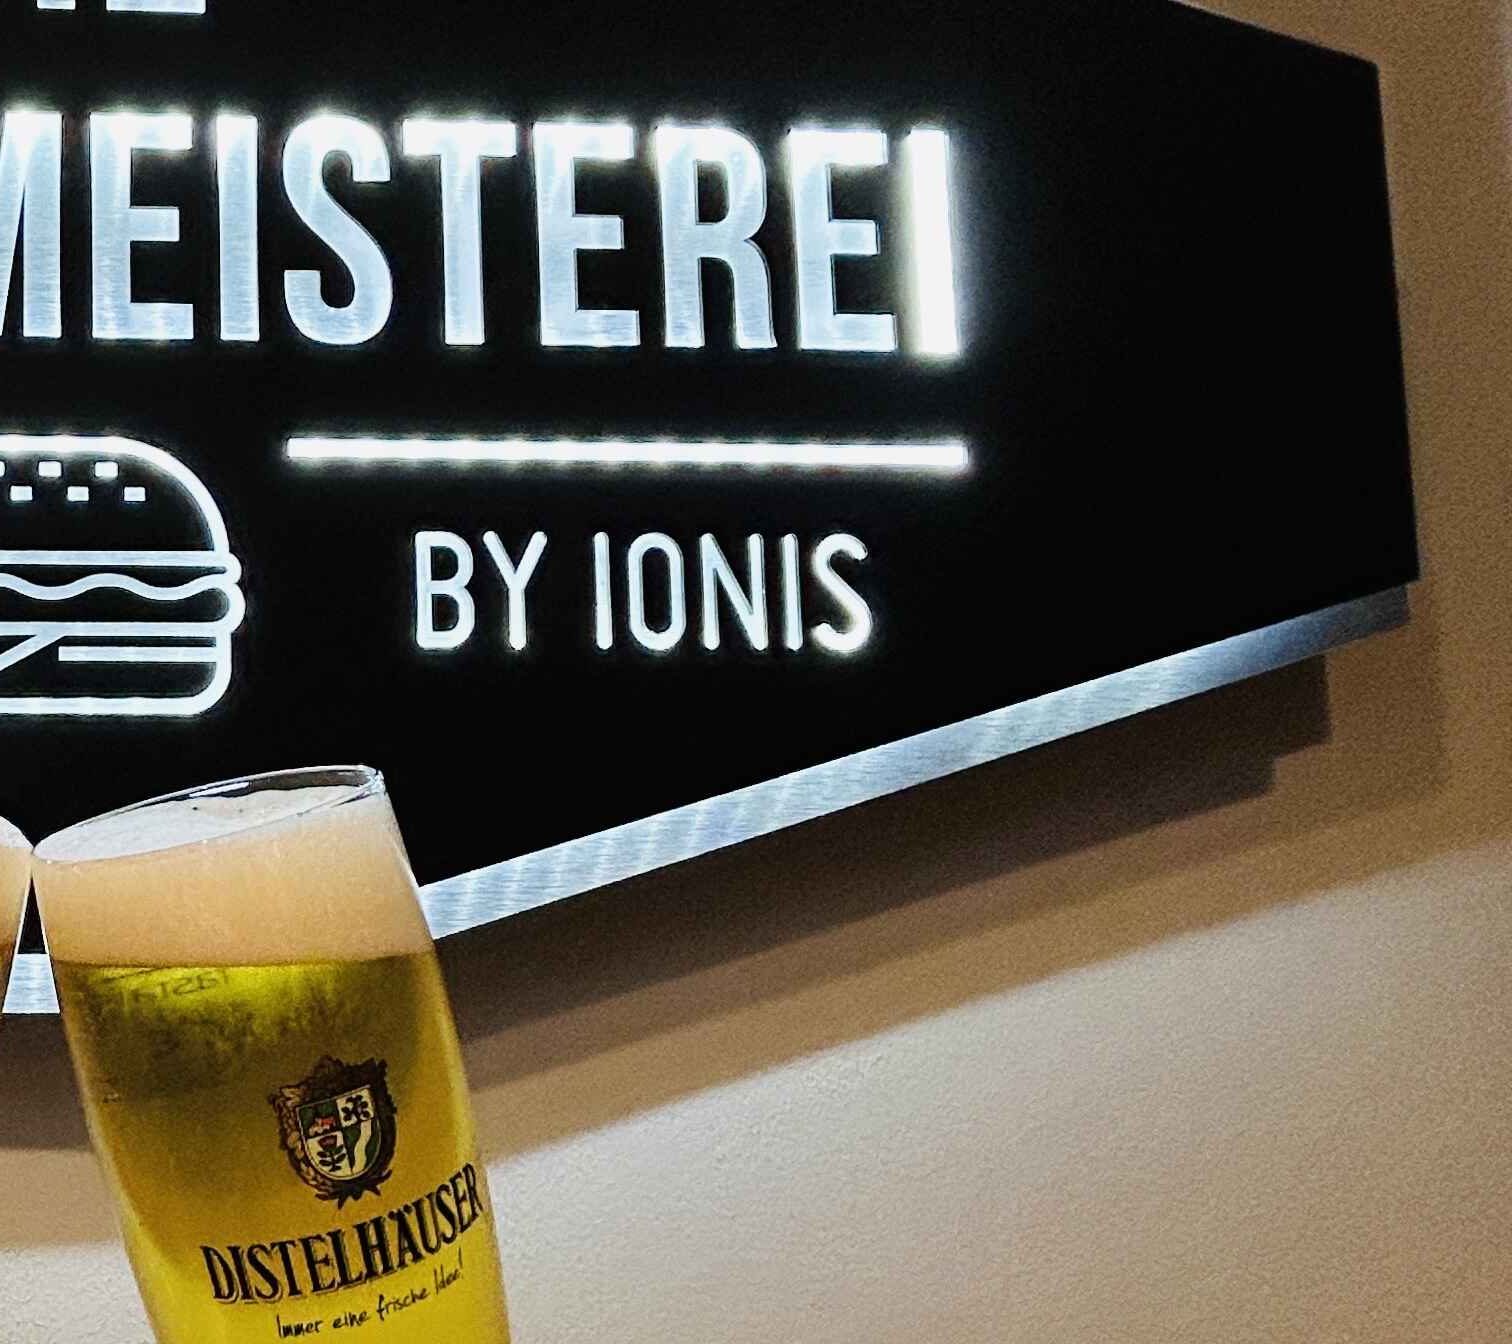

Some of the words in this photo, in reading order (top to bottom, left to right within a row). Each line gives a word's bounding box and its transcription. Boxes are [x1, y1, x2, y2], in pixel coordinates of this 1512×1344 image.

[413, 529, 548, 652] BY
[592, 530, 874, 657] IONIS
[199, 1162, 484, 1304] DISTELHÄUSER
[275, 1313, 324, 1340] Immer
[332, 1309, 369, 1330] eine
[376, 1284, 431, 1322] frische
[433, 1247, 465, 1296] Idee!
